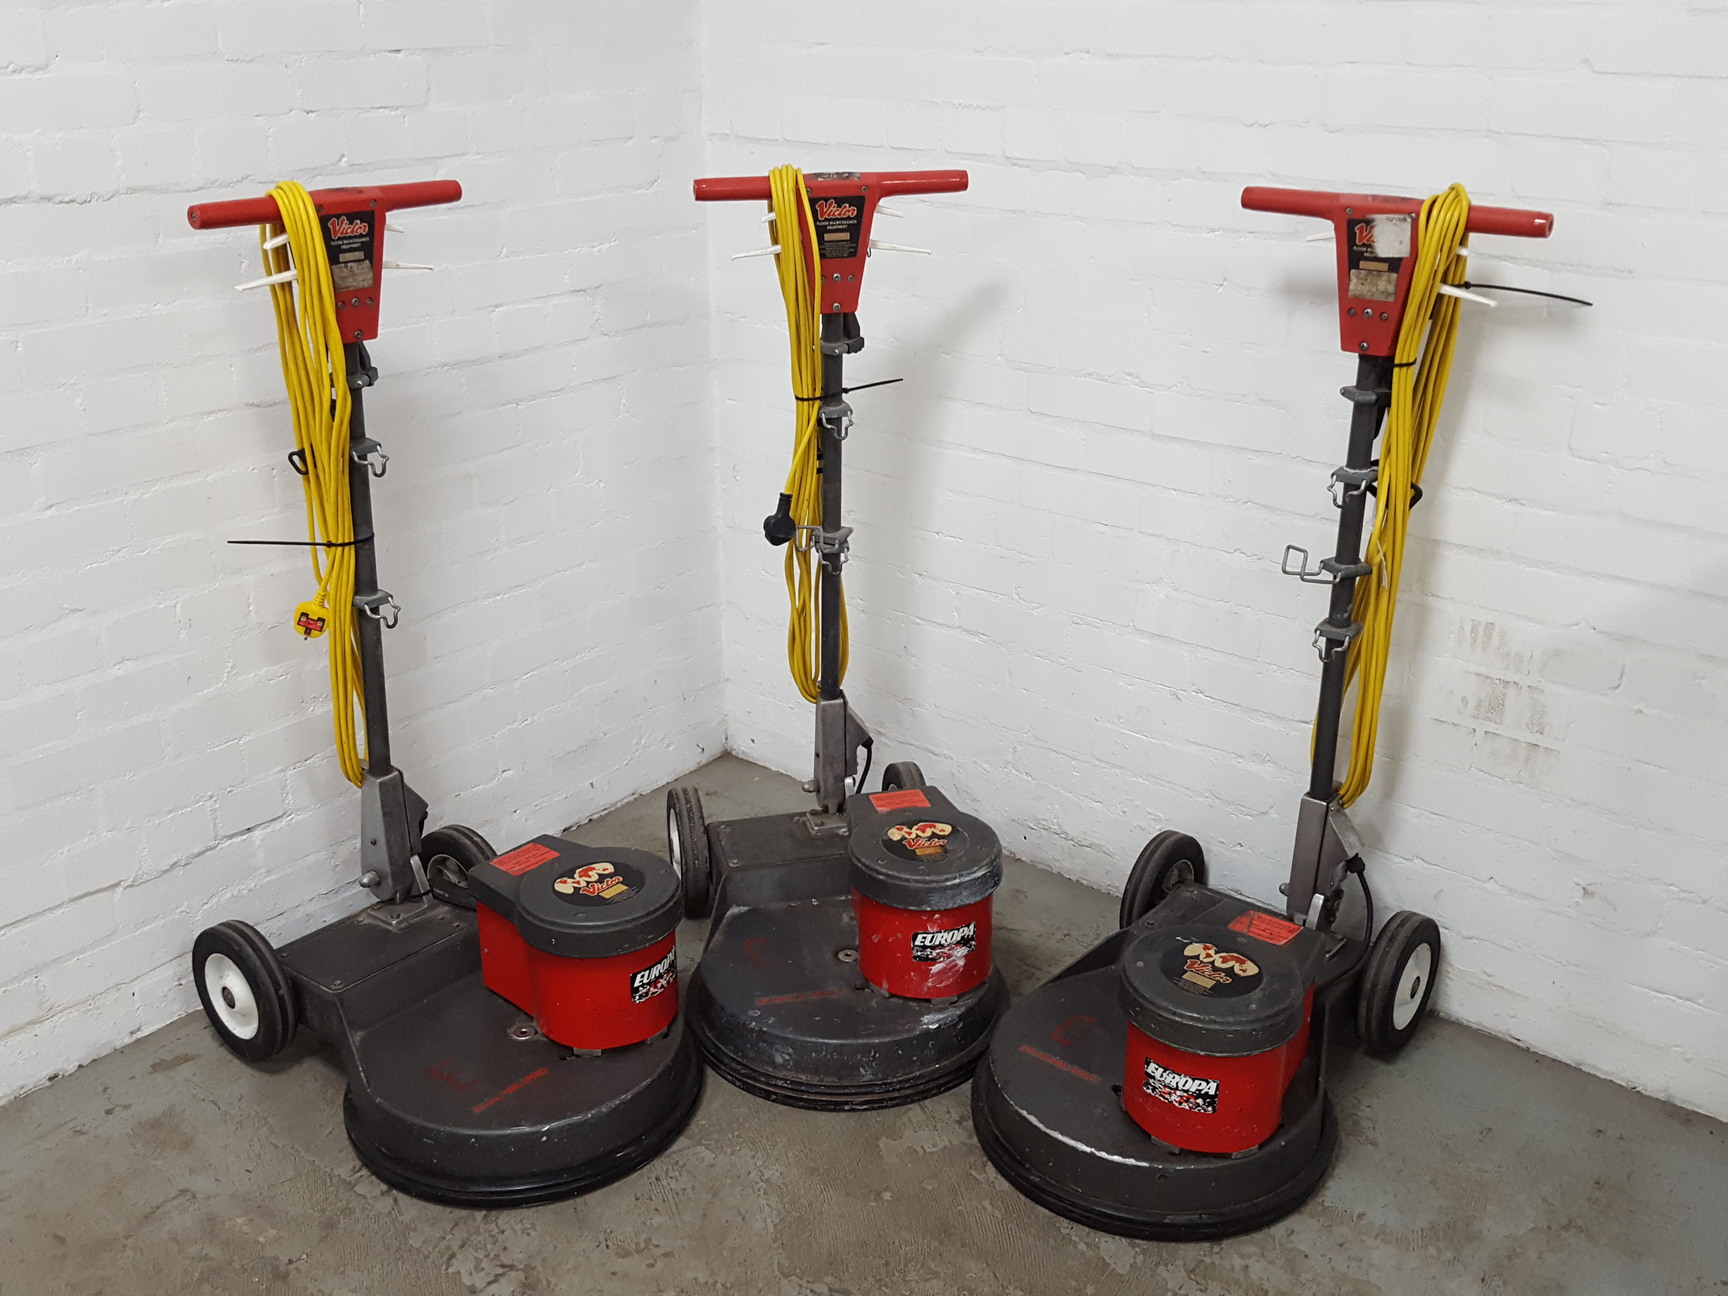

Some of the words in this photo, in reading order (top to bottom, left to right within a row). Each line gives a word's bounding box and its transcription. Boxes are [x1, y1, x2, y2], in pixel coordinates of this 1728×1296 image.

[816, 199, 857, 220] Victor
[328, 216, 368, 239] Victor
[902, 838, 948, 850] Victor
[579, 876, 623, 897] Victor
[914, 921, 976, 947] EUROPA
[1184, 959, 1232, 984] Victor
[1145, 1061, 1218, 1096] EUROPA
